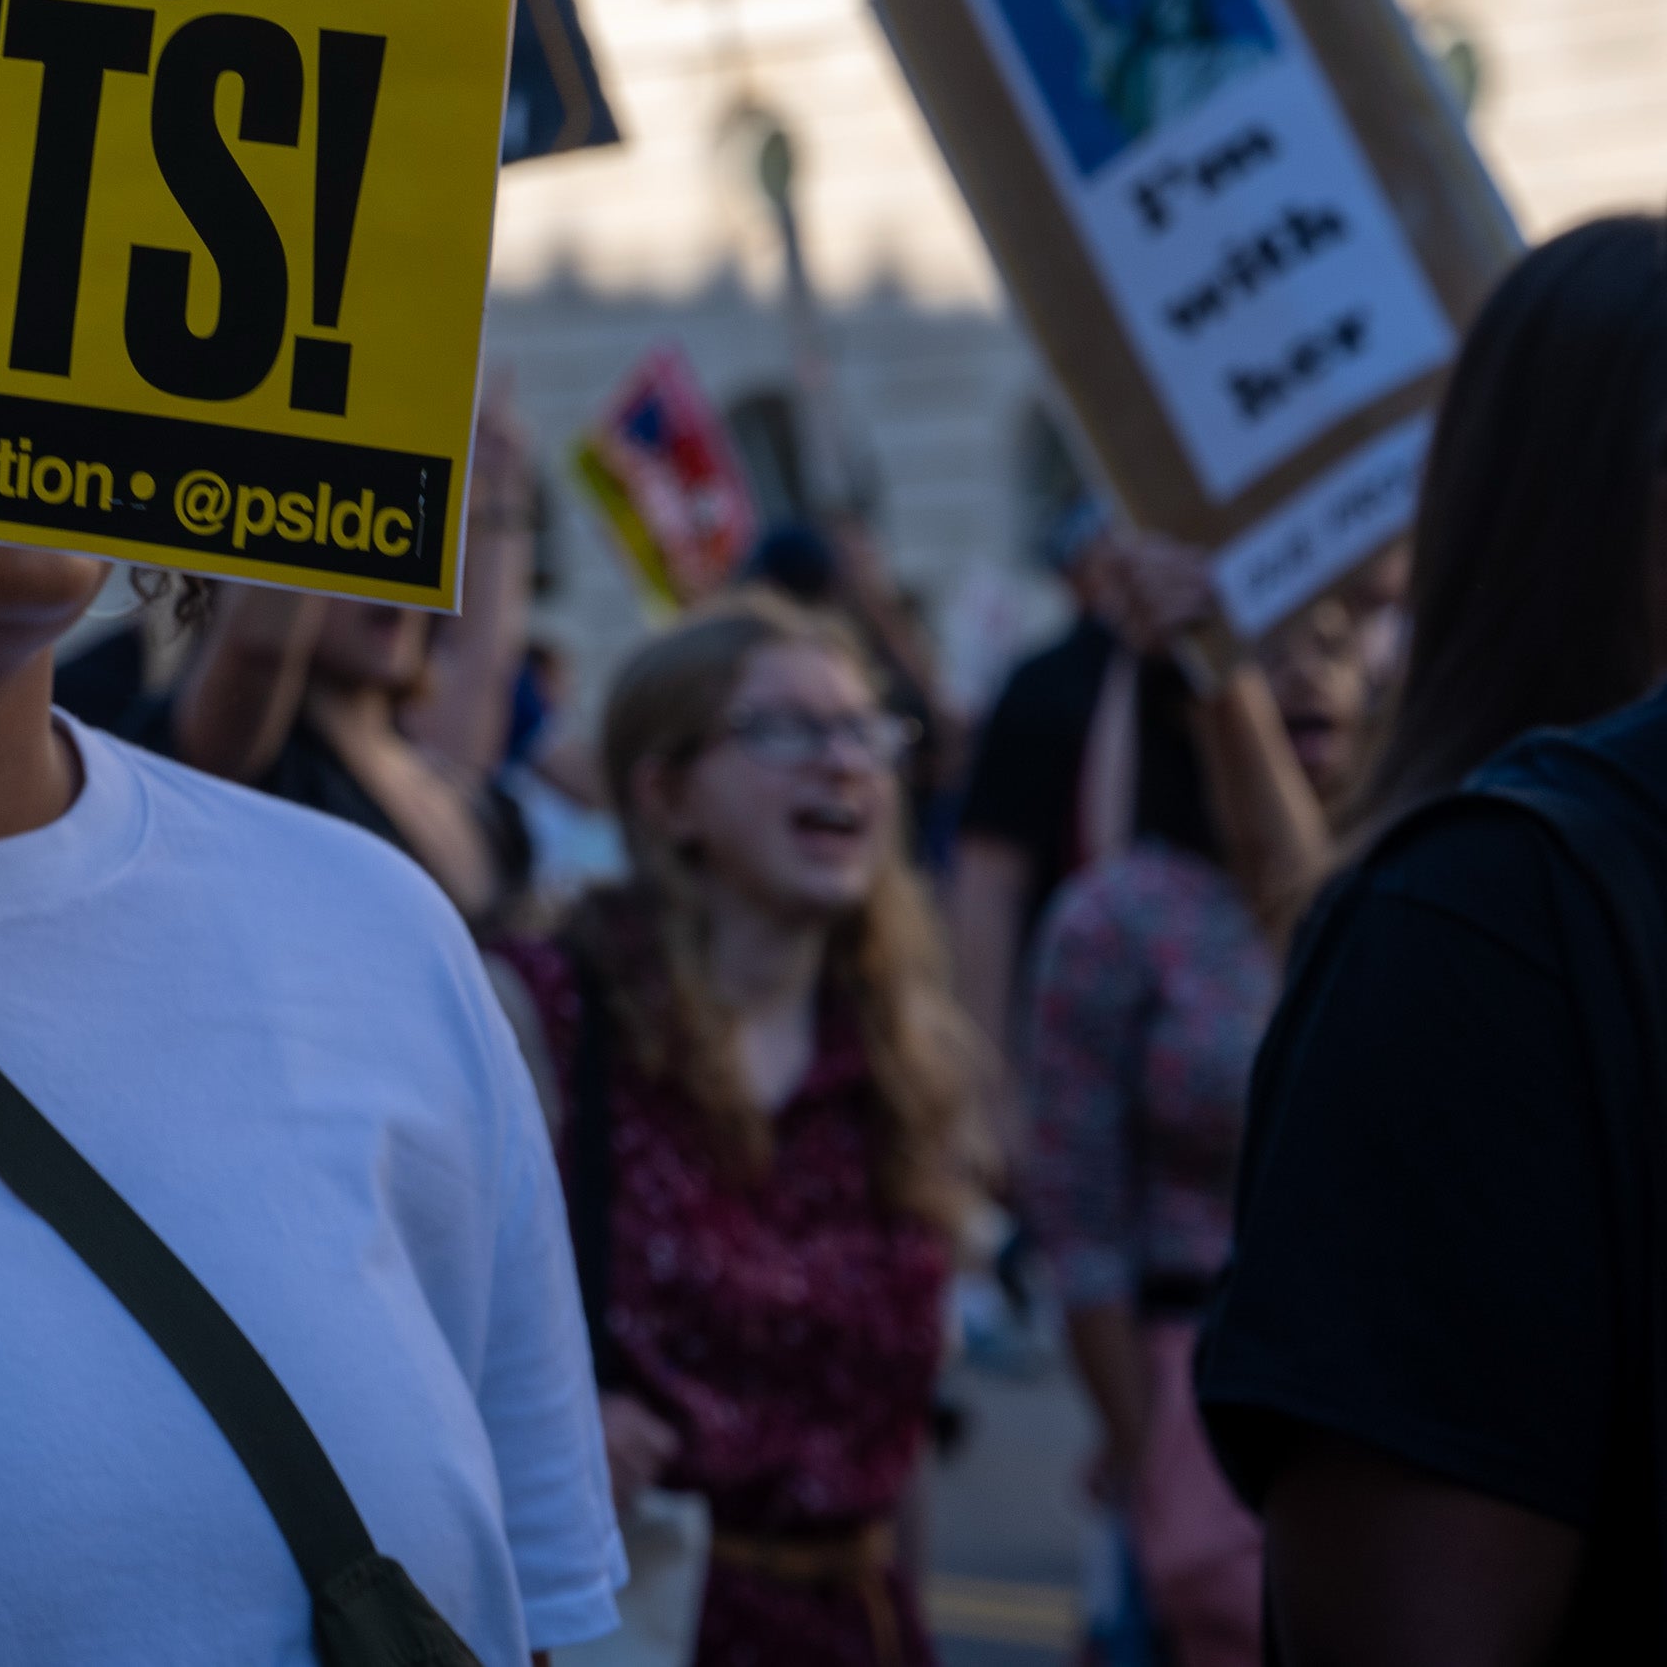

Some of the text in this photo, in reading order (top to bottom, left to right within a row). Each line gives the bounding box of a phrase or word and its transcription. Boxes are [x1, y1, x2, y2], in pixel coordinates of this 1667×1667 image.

[1131, 122, 1276, 233] I'm
[1166, 203, 1349, 334] with
[1227, 311, 1365, 422] her
[174, 470, 413, 557] @psldc
